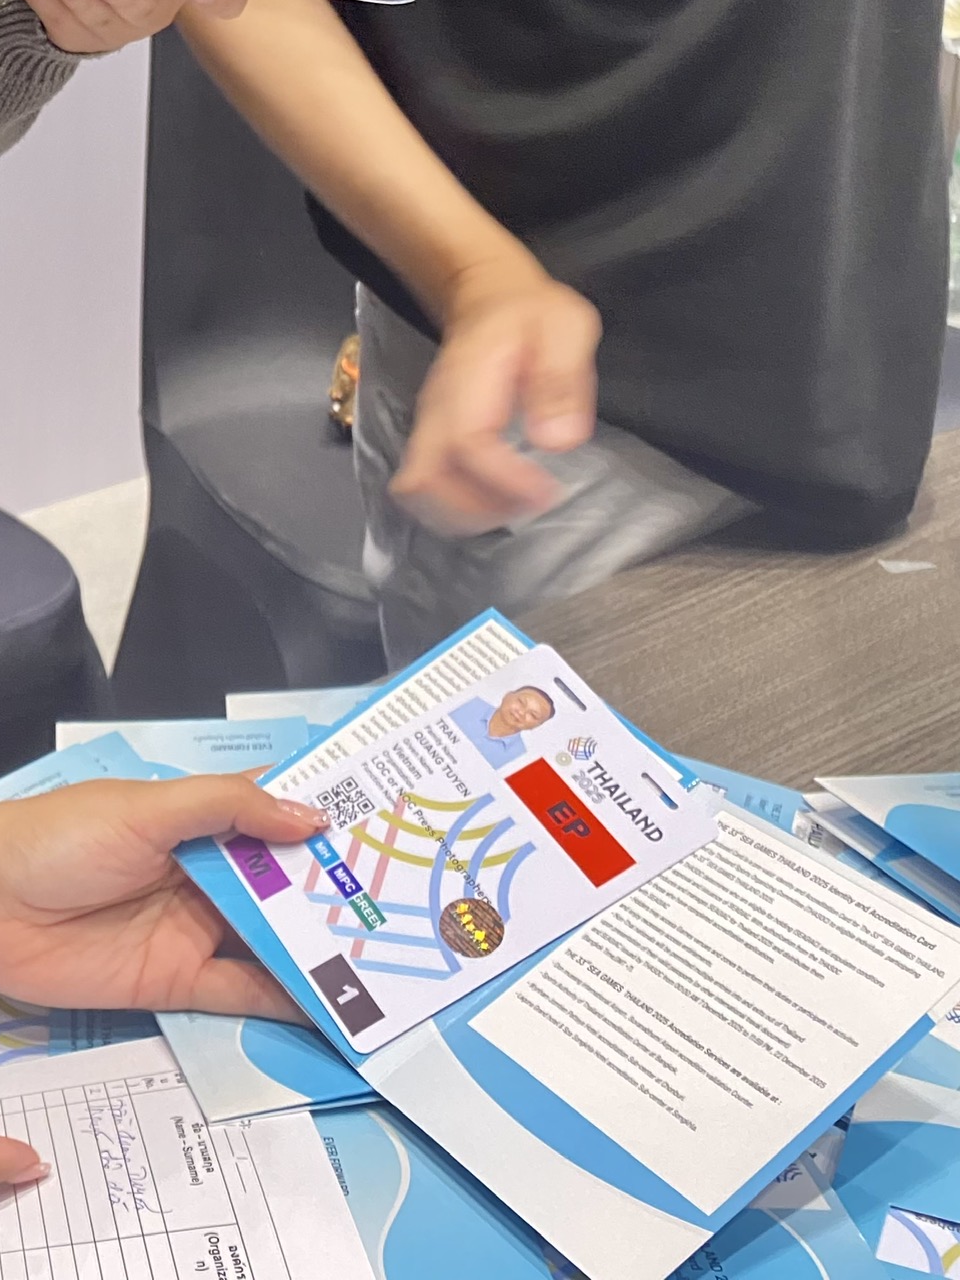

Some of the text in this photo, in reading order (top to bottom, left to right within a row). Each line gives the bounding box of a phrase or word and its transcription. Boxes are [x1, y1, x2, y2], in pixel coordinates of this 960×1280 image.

[435, 717, 460, 744] TRAN
[392, 742, 422, 780] Vietnam
[414, 731, 471, 798] QUANG TUYEN
[370, 755, 391, 777] LOC
[387, 776, 398, 787] or
[395, 786, 417, 810] NOC
[413, 809, 439, 838] Press
[571, 769, 606, 804] 2025
[587, 760, 664, 842] THAILAND
[546, 799, 591, 839] EP
[243, 851, 273, 879] M
[333, 867, 357, 893] MPC
[353, 893, 381, 929] GREEN
[740, 834, 754, 846] SEA
[753, 842, 778, 859] GAMES
[776, 855, 811, 878] THAILAND
[809, 875, 830, 889] 2025
[827, 885, 856, 904] Identity
[854, 901, 871, 913] and
[868, 909, 917, 940] Accreditation
[916, 936, 937, 950] Card
[336, 984, 360, 1006] 1
[586, 964, 602, 977] SEA
[599, 973, 624, 993] GAMES
[624, 990, 654, 1014] THAILAND
[651, 1011, 670, 1025] 2025
[703, 1048, 731, 1070] Services
[729, 1067, 742, 1077] are
[740, 1075, 771, 1097] available
[769, 1095, 779, 1103] at
[169, 1115, 187, 1139] (Name
[182, 1145, 204, 1187] Surname)
[323, 1137, 338, 1157] EVER
